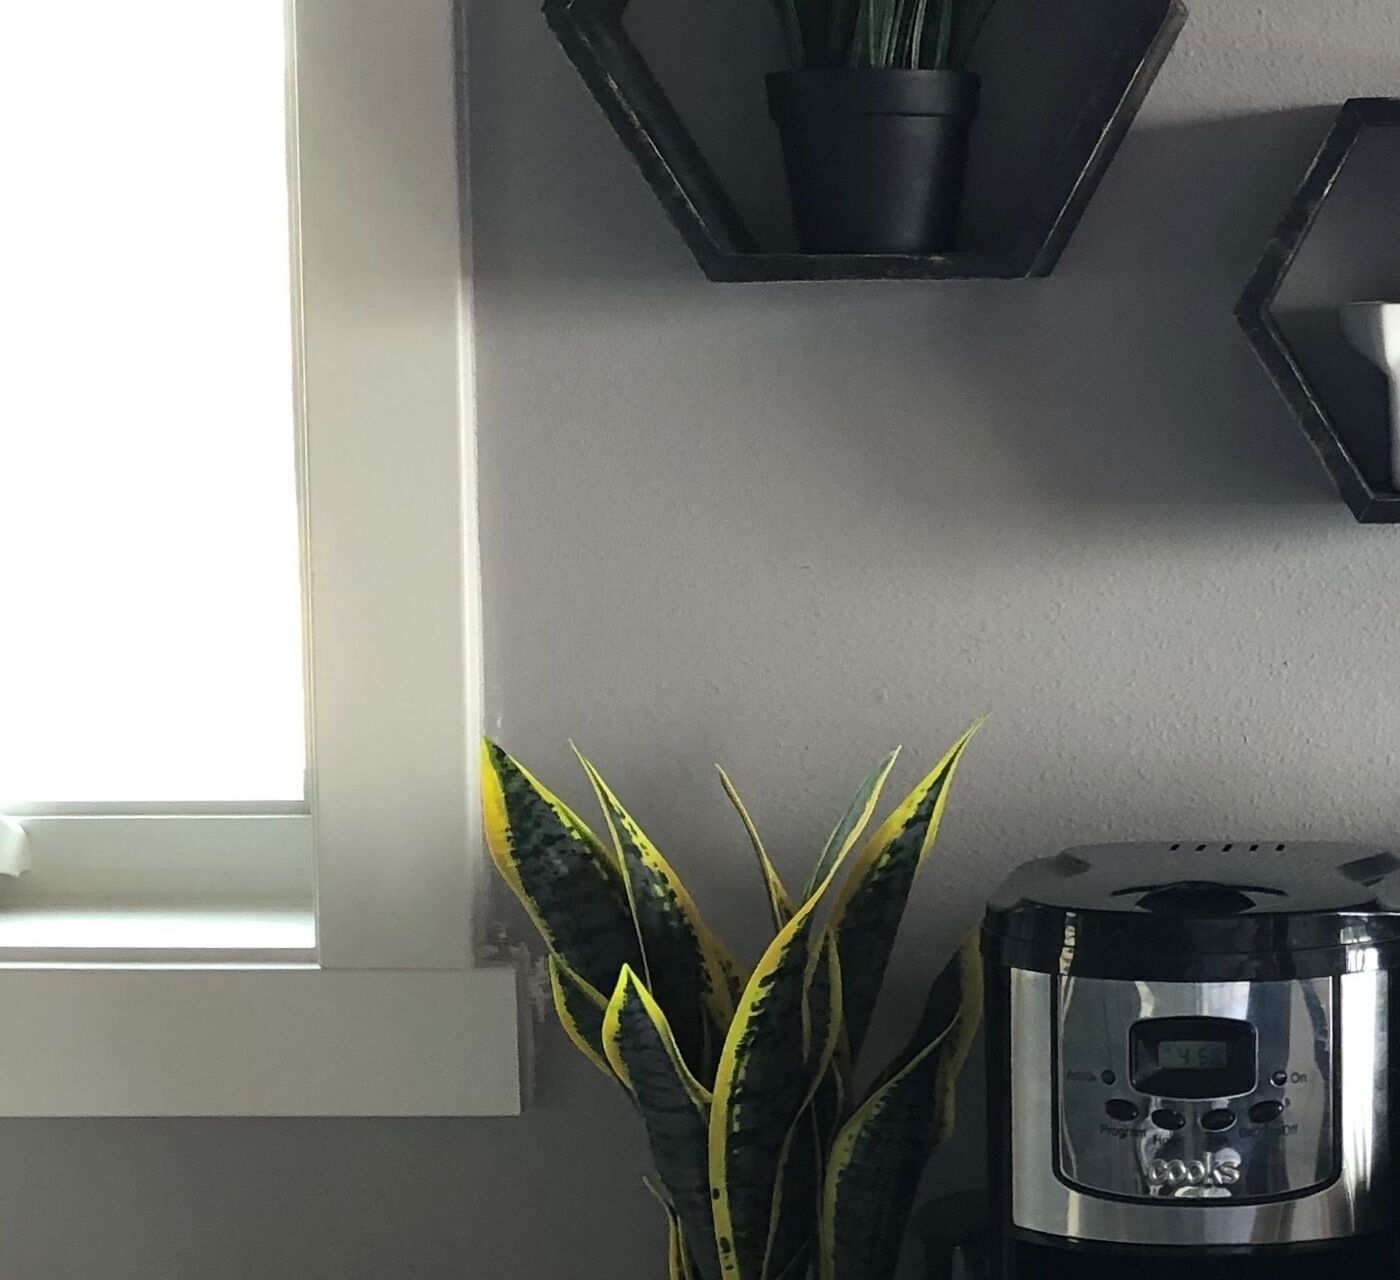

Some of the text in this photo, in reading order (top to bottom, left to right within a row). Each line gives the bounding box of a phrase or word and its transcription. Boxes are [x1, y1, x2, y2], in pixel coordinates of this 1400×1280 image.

[1290, 1071, 1308, 1084] On
[1100, 1123, 1148, 1140] Program
[1149, 1151, 1241, 1185] cooks
